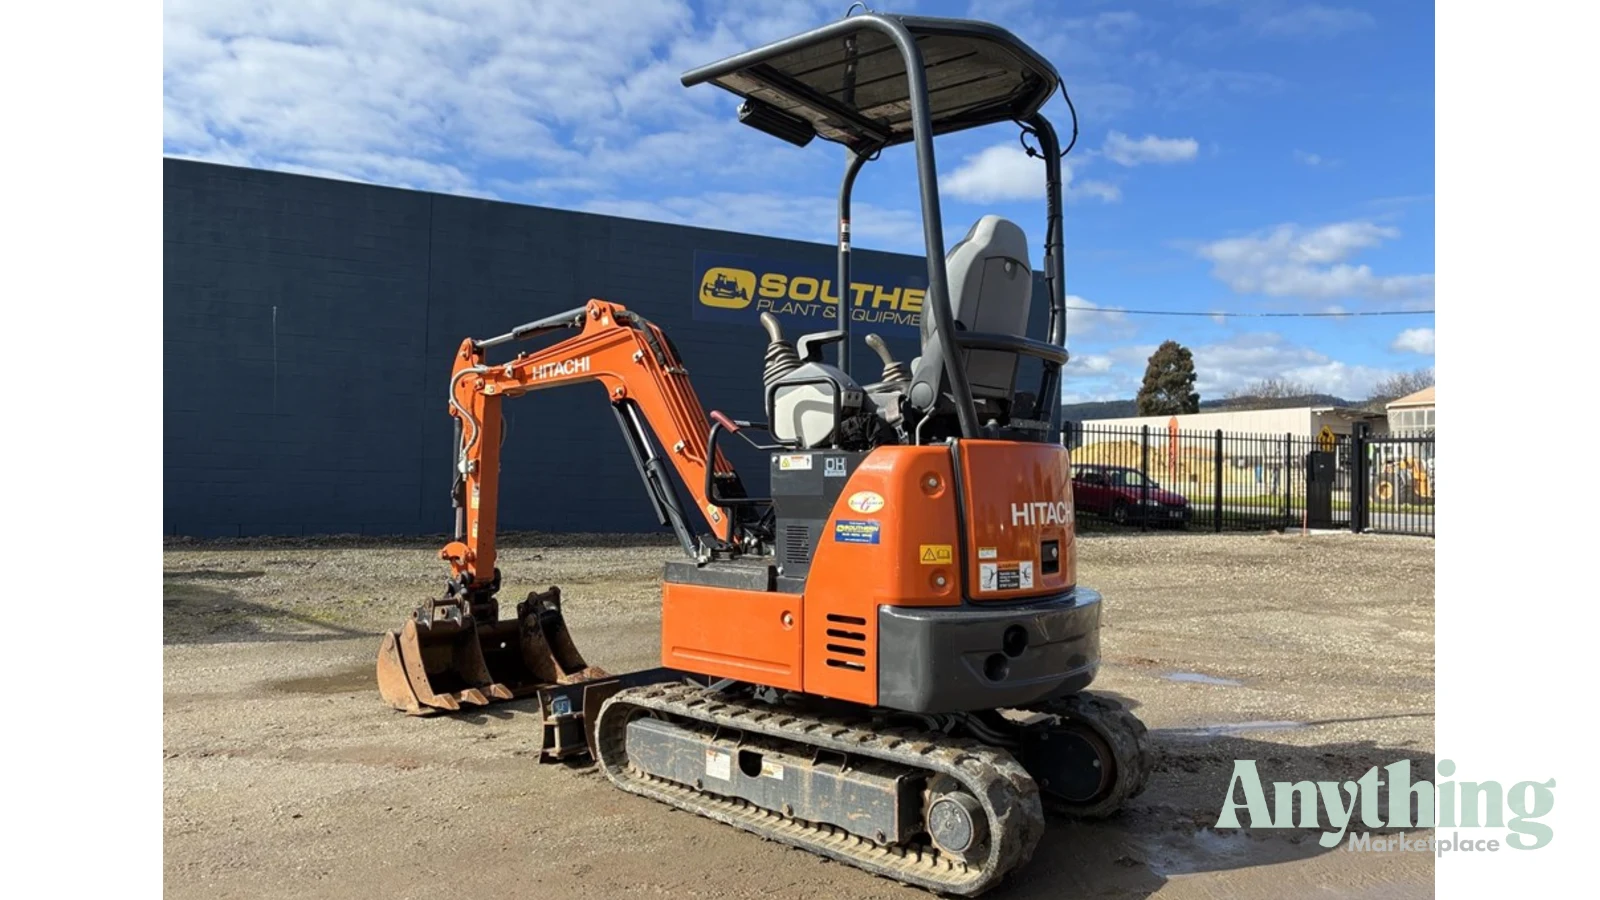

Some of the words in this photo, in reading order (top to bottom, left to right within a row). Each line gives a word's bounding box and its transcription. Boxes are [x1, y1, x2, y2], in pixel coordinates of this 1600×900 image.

[758, 272, 926, 312] SOUTHE
[756, 299, 821, 317] PLANT
[822, 305, 837, 318] &
[846, 308, 921, 326] QUIPME
[532, 356, 590, 380] HITACHI
